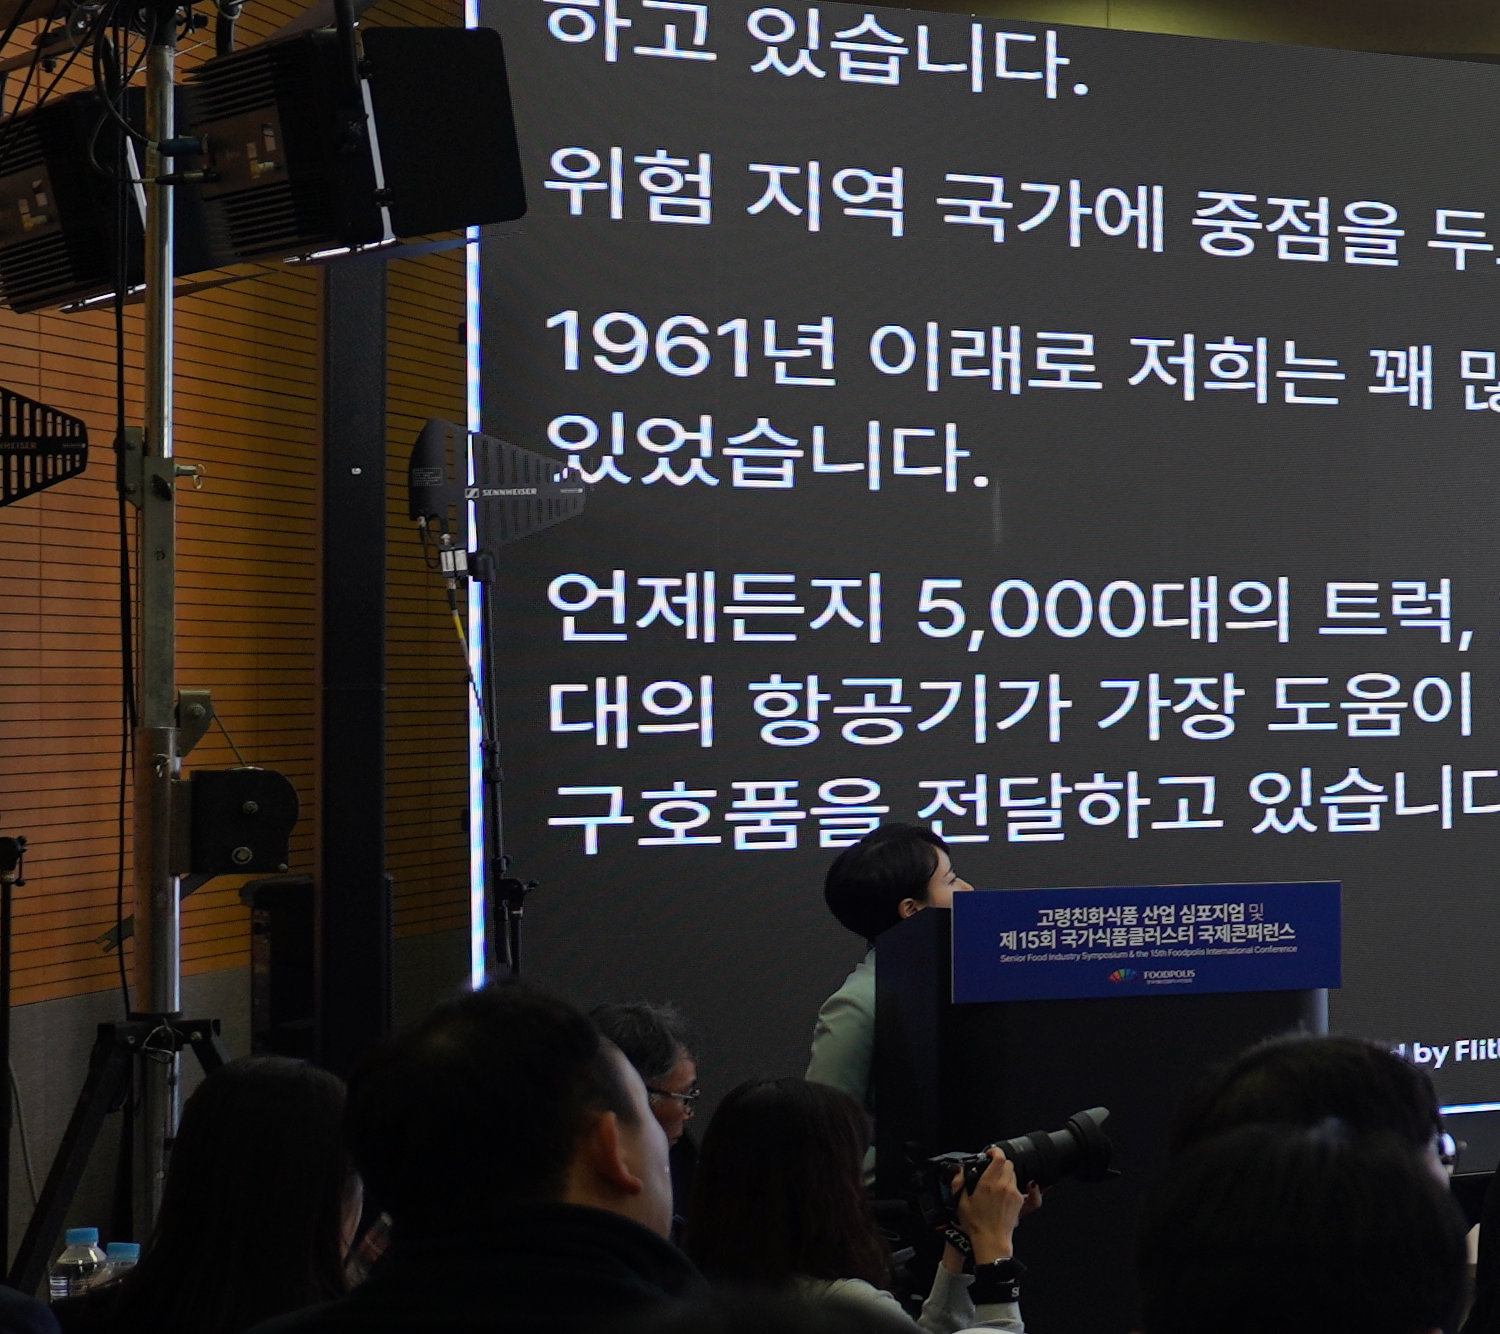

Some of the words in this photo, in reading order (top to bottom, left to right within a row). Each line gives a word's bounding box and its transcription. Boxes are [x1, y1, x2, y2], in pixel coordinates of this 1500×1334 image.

[748, 8, 1090, 98] 있습니다.
[544, 147, 711, 224] 위험
[747, 161, 903, 236] 지역
[937, 174, 1163, 252] 국가에
[1192, 192, 1405, 266] 중점을
[547, 310, 835, 386] 1961년
[870, 322, 1102, 394] 이래로
[1128, 334, 1345, 404] 저희는
[1369, 345, 1432, 410] 꽤
[547, 412, 988, 492] 있었습니다.
[548, 570, 880, 643] 언제든지
[918, 576, 1288, 651] 5,000대의
[1319, 579, 1472, 651] 트럭,
[550, 675, 712, 748] 대의
[749, 674, 1072, 746] 항공기가
[1098, 673, 1245, 740] 가장
[1268, 672, 1471, 736] 도움이
[548, 778, 889, 854] 구호품을
[918, 771, 1223, 843] 전달하고
[1000, 930, 1057, 950] 제15회
[1061, 926, 1194, 949] 국가식품클러스터
[1198, 923, 1296, 944] 국제콘퍼런스
[1037, 907, 1138, 928] 고령친화식품
[1143, 906, 1174, 925] 산업
[1180, 903, 1244, 923] 심포지엄
[1249, 903, 1264, 921] 및
[1000, 954, 1026, 963] Senior
[1027, 953, 1047, 962] Food
[1129, 950, 1136, 958] &
[1413, 1042, 1449, 1069] by
